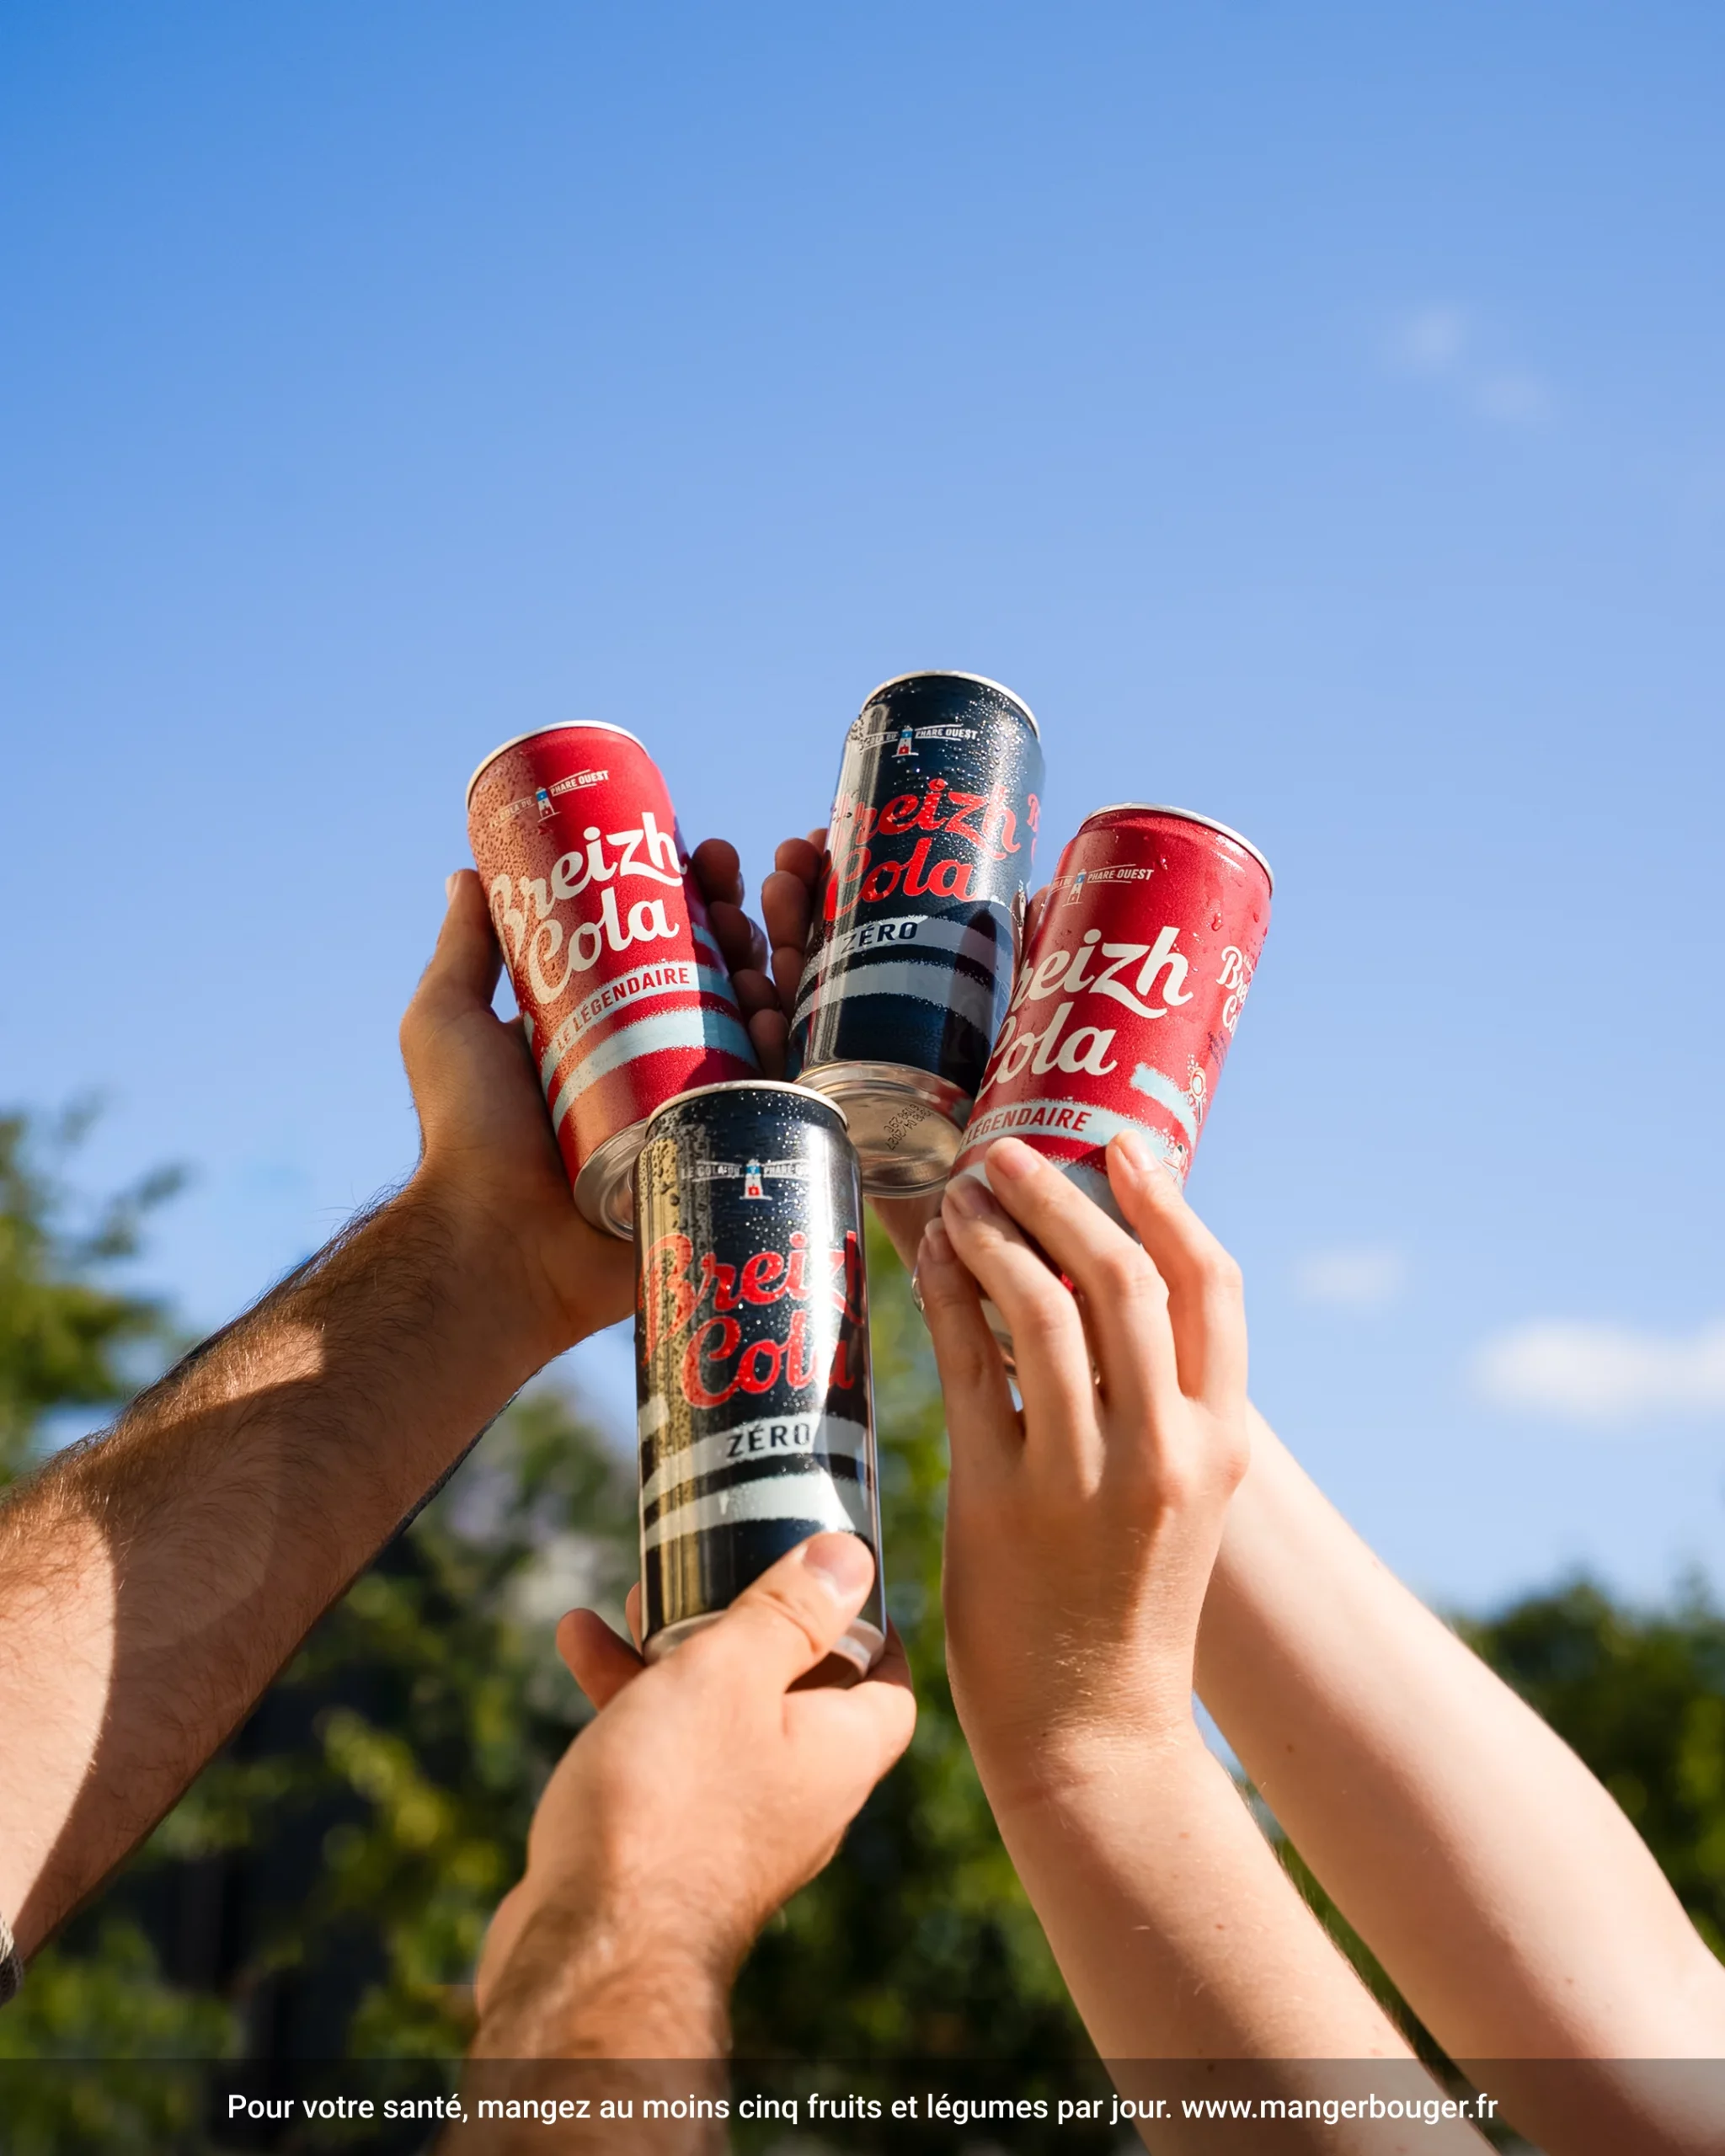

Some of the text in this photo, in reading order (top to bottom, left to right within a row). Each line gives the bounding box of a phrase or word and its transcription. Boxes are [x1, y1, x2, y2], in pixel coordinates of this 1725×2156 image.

[915, 728, 943, 738] PHARE
[945, 728, 978, 740] OUEST
[550, 779, 578, 795] PHARE
[579, 770, 609, 785] OUEST
[489, 811, 688, 985] Breizh
[822, 837, 979, 922] Cola
[1087, 867, 1155, 882] PHARE OUEST
[529, 886, 680, 1004] Cola
[841, 921, 919, 954] ZÉRO
[1011, 926, 1194, 1019] reizh
[556, 967, 690, 1053] LE LÉGENDAIRE
[975, 1001, 1119, 1104] Cola
[964, 1106, 1092, 1146] LÉGENDAIRE
[725, 1422, 810, 1459] ZÉRO
